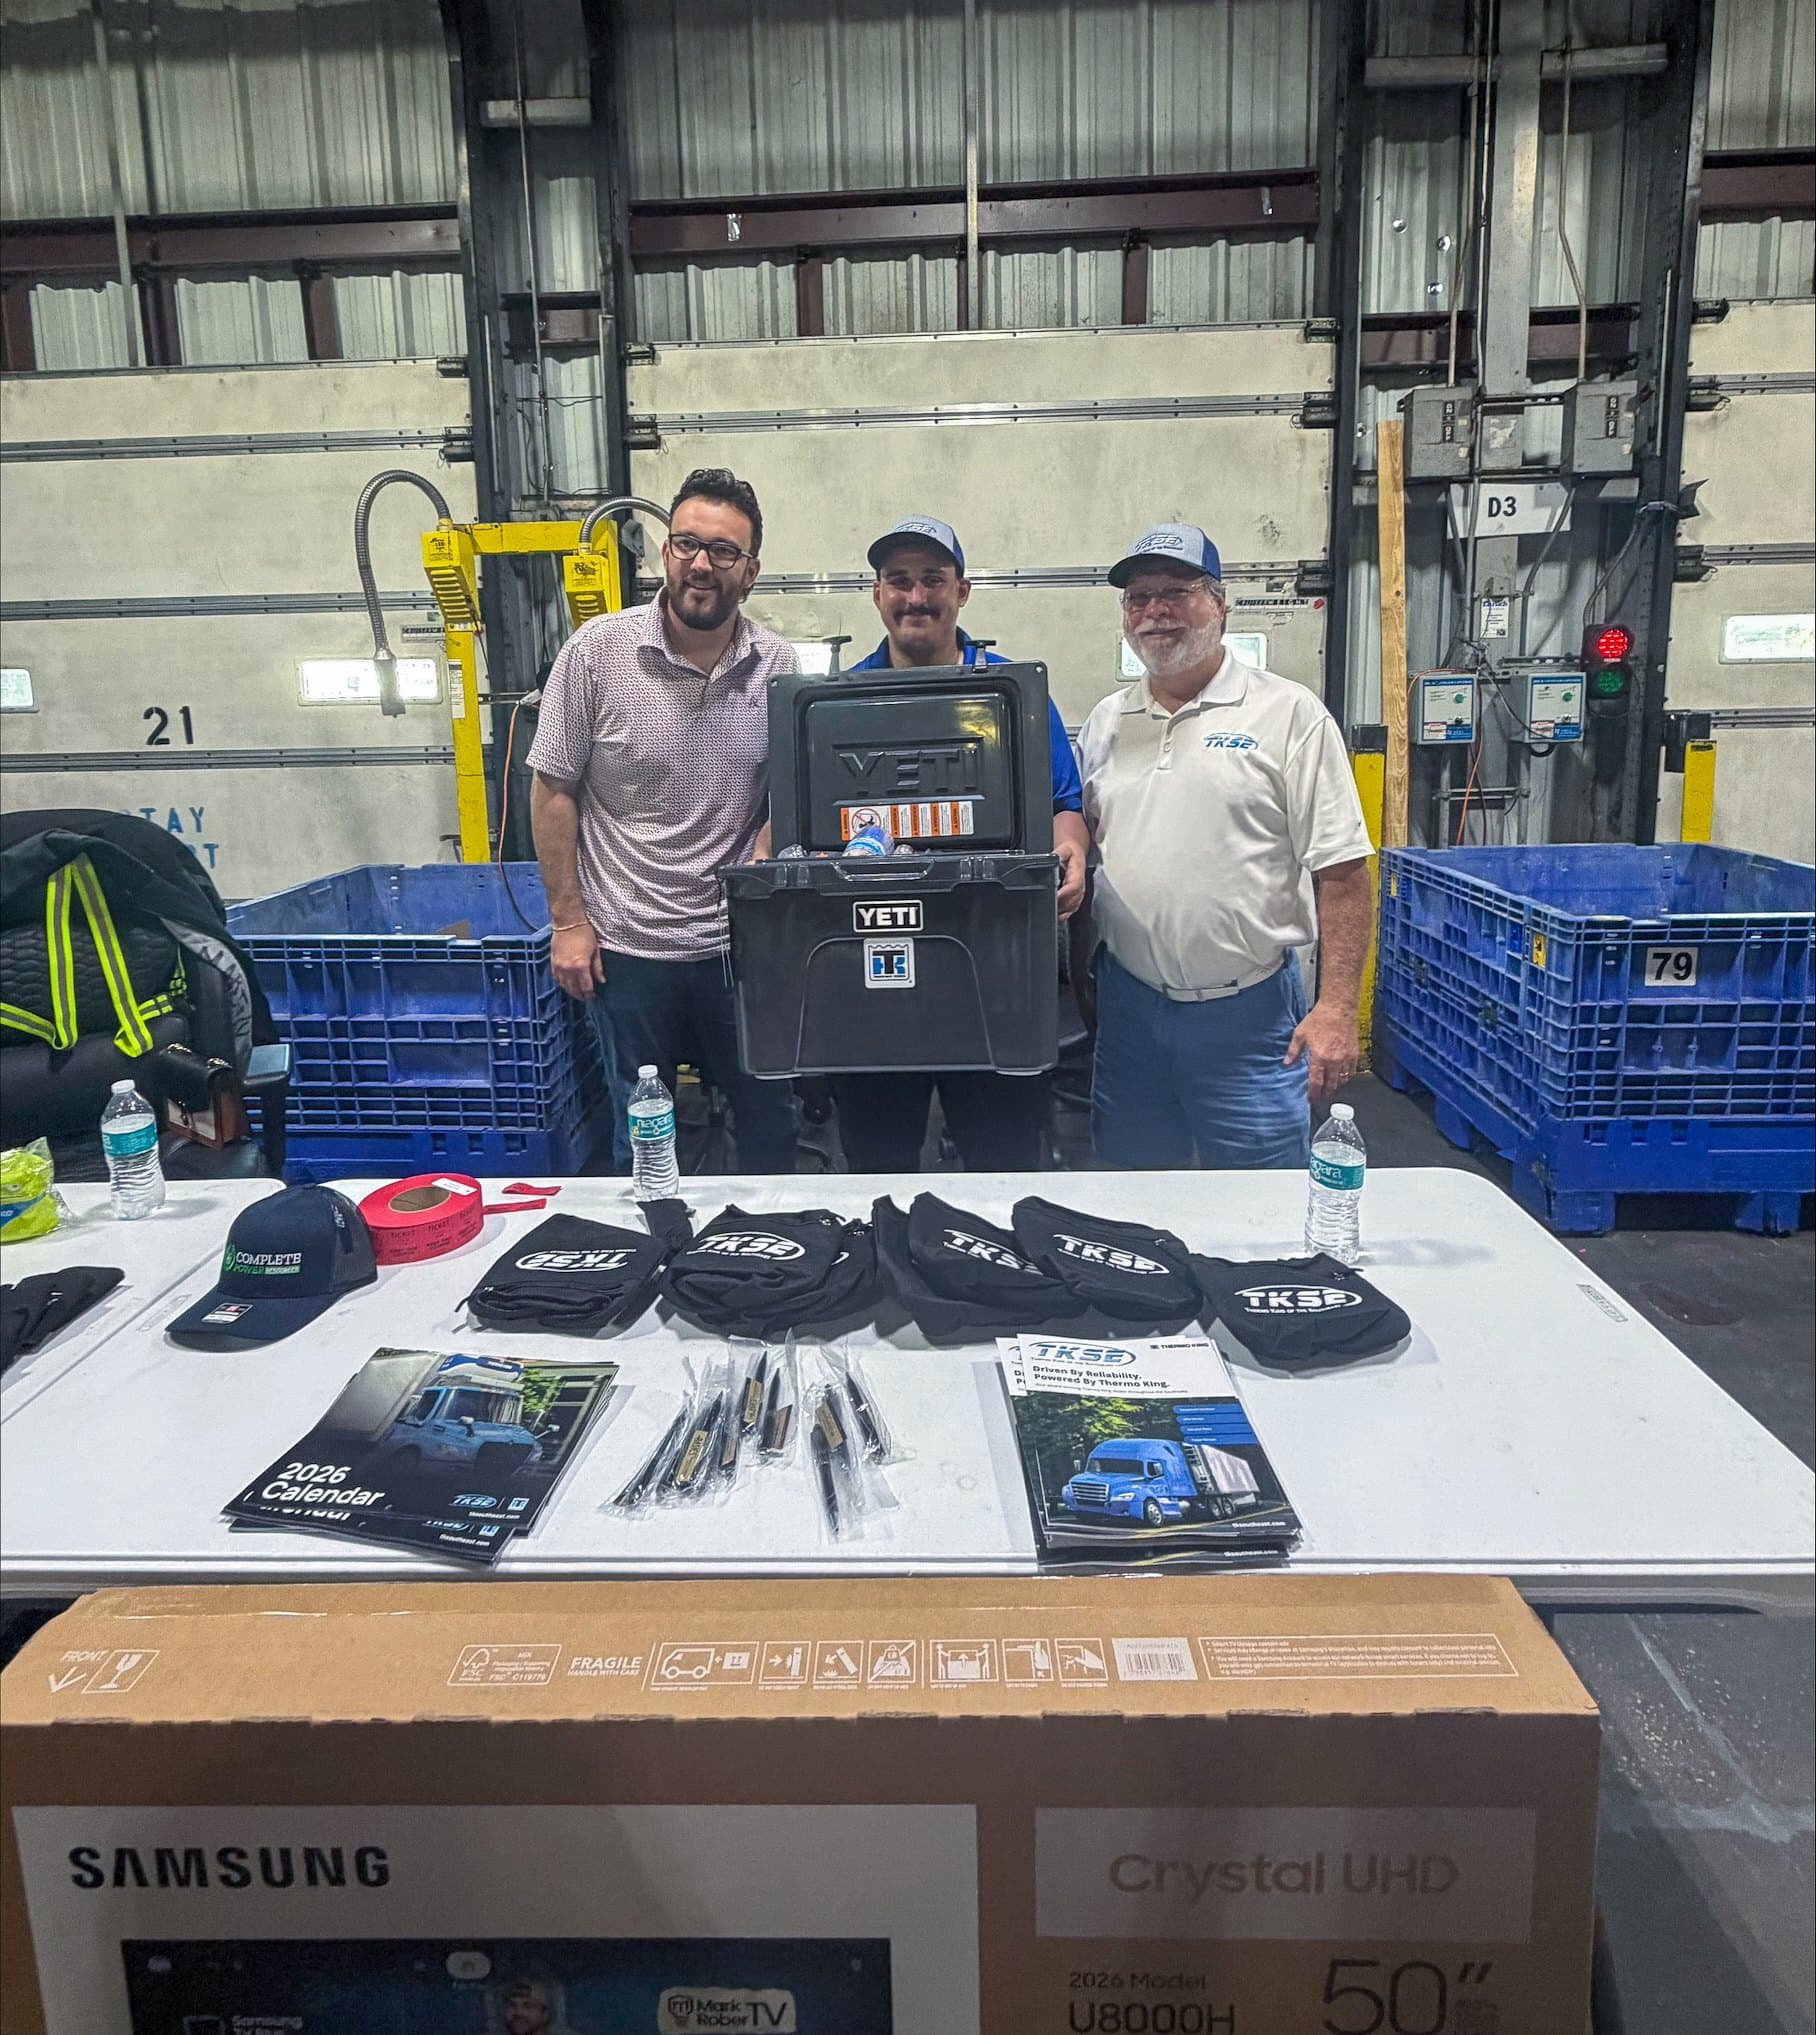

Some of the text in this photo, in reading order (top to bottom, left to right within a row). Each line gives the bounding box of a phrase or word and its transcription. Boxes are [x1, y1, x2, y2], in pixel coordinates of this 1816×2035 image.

[1487, 496, 1517, 518] D3
[143, 706, 194, 745] 21
[1205, 736, 1253, 749] TKSE
[839, 751, 978, 796] YETI
[118, 807, 205, 833] TAY
[858, 907, 918, 926] YETI
[1651, 952, 1693, 981] 79
[697, 1236, 794, 1256] TKSE
[1061, 1235, 1156, 1270] TKSE
[236, 1252, 301, 1266] COMPLETE
[233, 1264, 264, 1274] POWER
[1242, 1290, 1347, 1307] TKSE
[1036, 1345, 1126, 1363] TKSE
[1033, 1366, 1142, 1380] Driven By Reliability.
[1034, 1374, 1080, 1384] Powered
[1083, 1377, 1096, 1386] By
[1099, 1379, 1141, 1388] Thermo
[277, 1462, 351, 1484] 2026
[262, 1481, 385, 1506] Calendar
[61, 1650, 109, 1662] FRONT
[570, 1657, 643, 1669] FRAGILE
[599, 1669, 619, 1677] WITH
[620, 1668, 640, 1676] CARE
[69, 1846, 390, 1888] SAMSUNG
[1108, 1852, 1459, 1899] Crystal UHD
[1069, 1971, 1206, 1990] 2026 Model
[697, 1999, 787, 2026] Mark TV
[697, 2013, 749, 2026] Rober
[1068, 2002, 1236, 2035] U8000H
